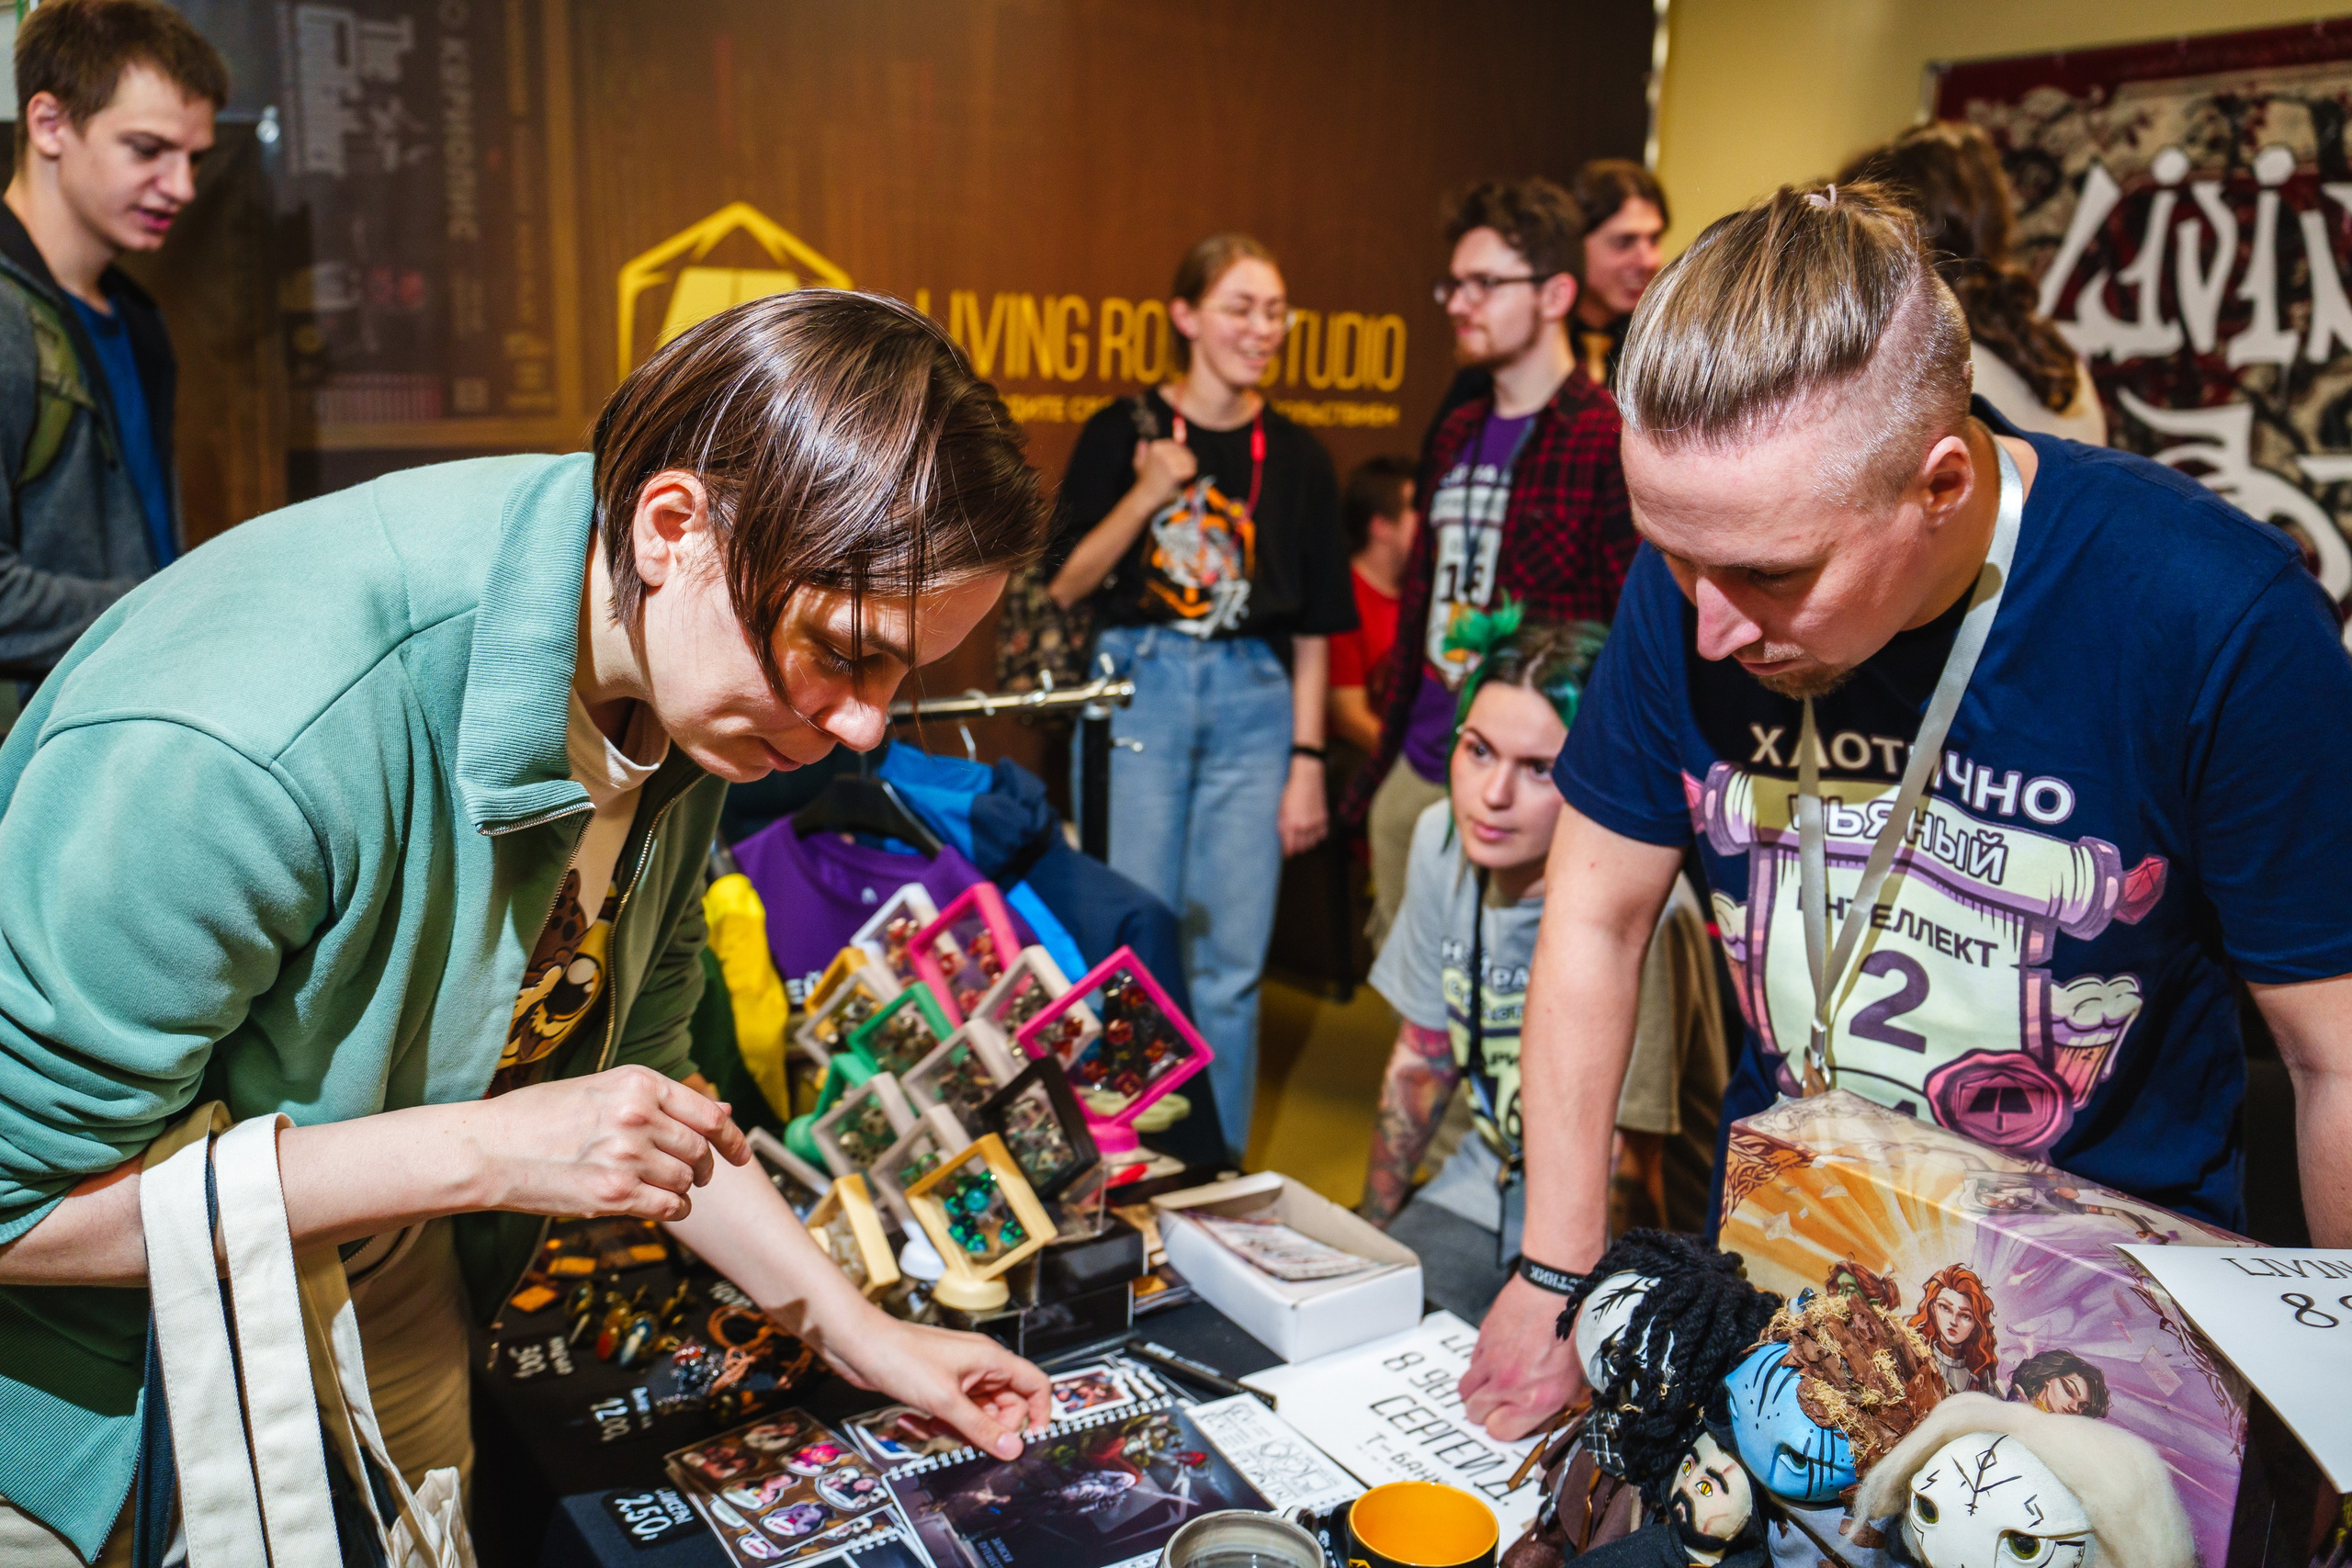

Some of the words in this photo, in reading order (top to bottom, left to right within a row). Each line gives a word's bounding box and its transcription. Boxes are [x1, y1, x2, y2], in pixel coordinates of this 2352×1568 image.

[916, 288, 1091, 383] IVING
[1259, 308, 1408, 392] TUDIO
[1849, 950, 1931, 1055] 2
